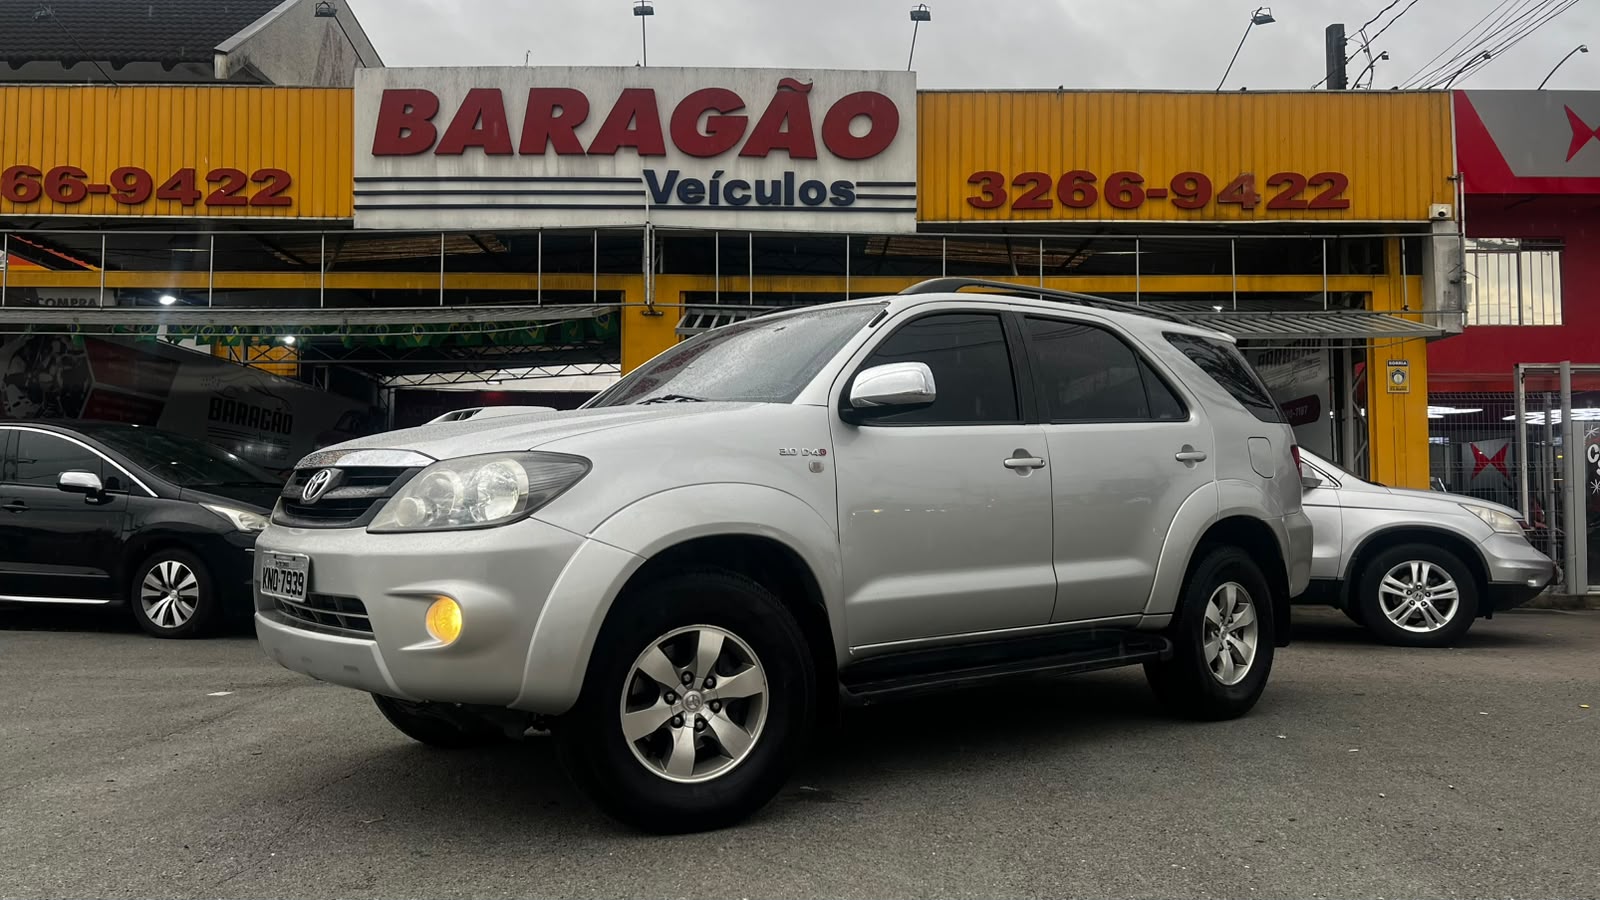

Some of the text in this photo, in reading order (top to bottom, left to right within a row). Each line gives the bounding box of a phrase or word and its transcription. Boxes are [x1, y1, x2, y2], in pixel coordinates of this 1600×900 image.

[371, 77, 899, 161] BARAGÃO
[1, 165, 293, 207] 66-9422
[642, 168, 856, 207] Veículos
[966, 170, 1350, 210] 3266-9422
[208, 397, 293, 434] BARAGÃO
